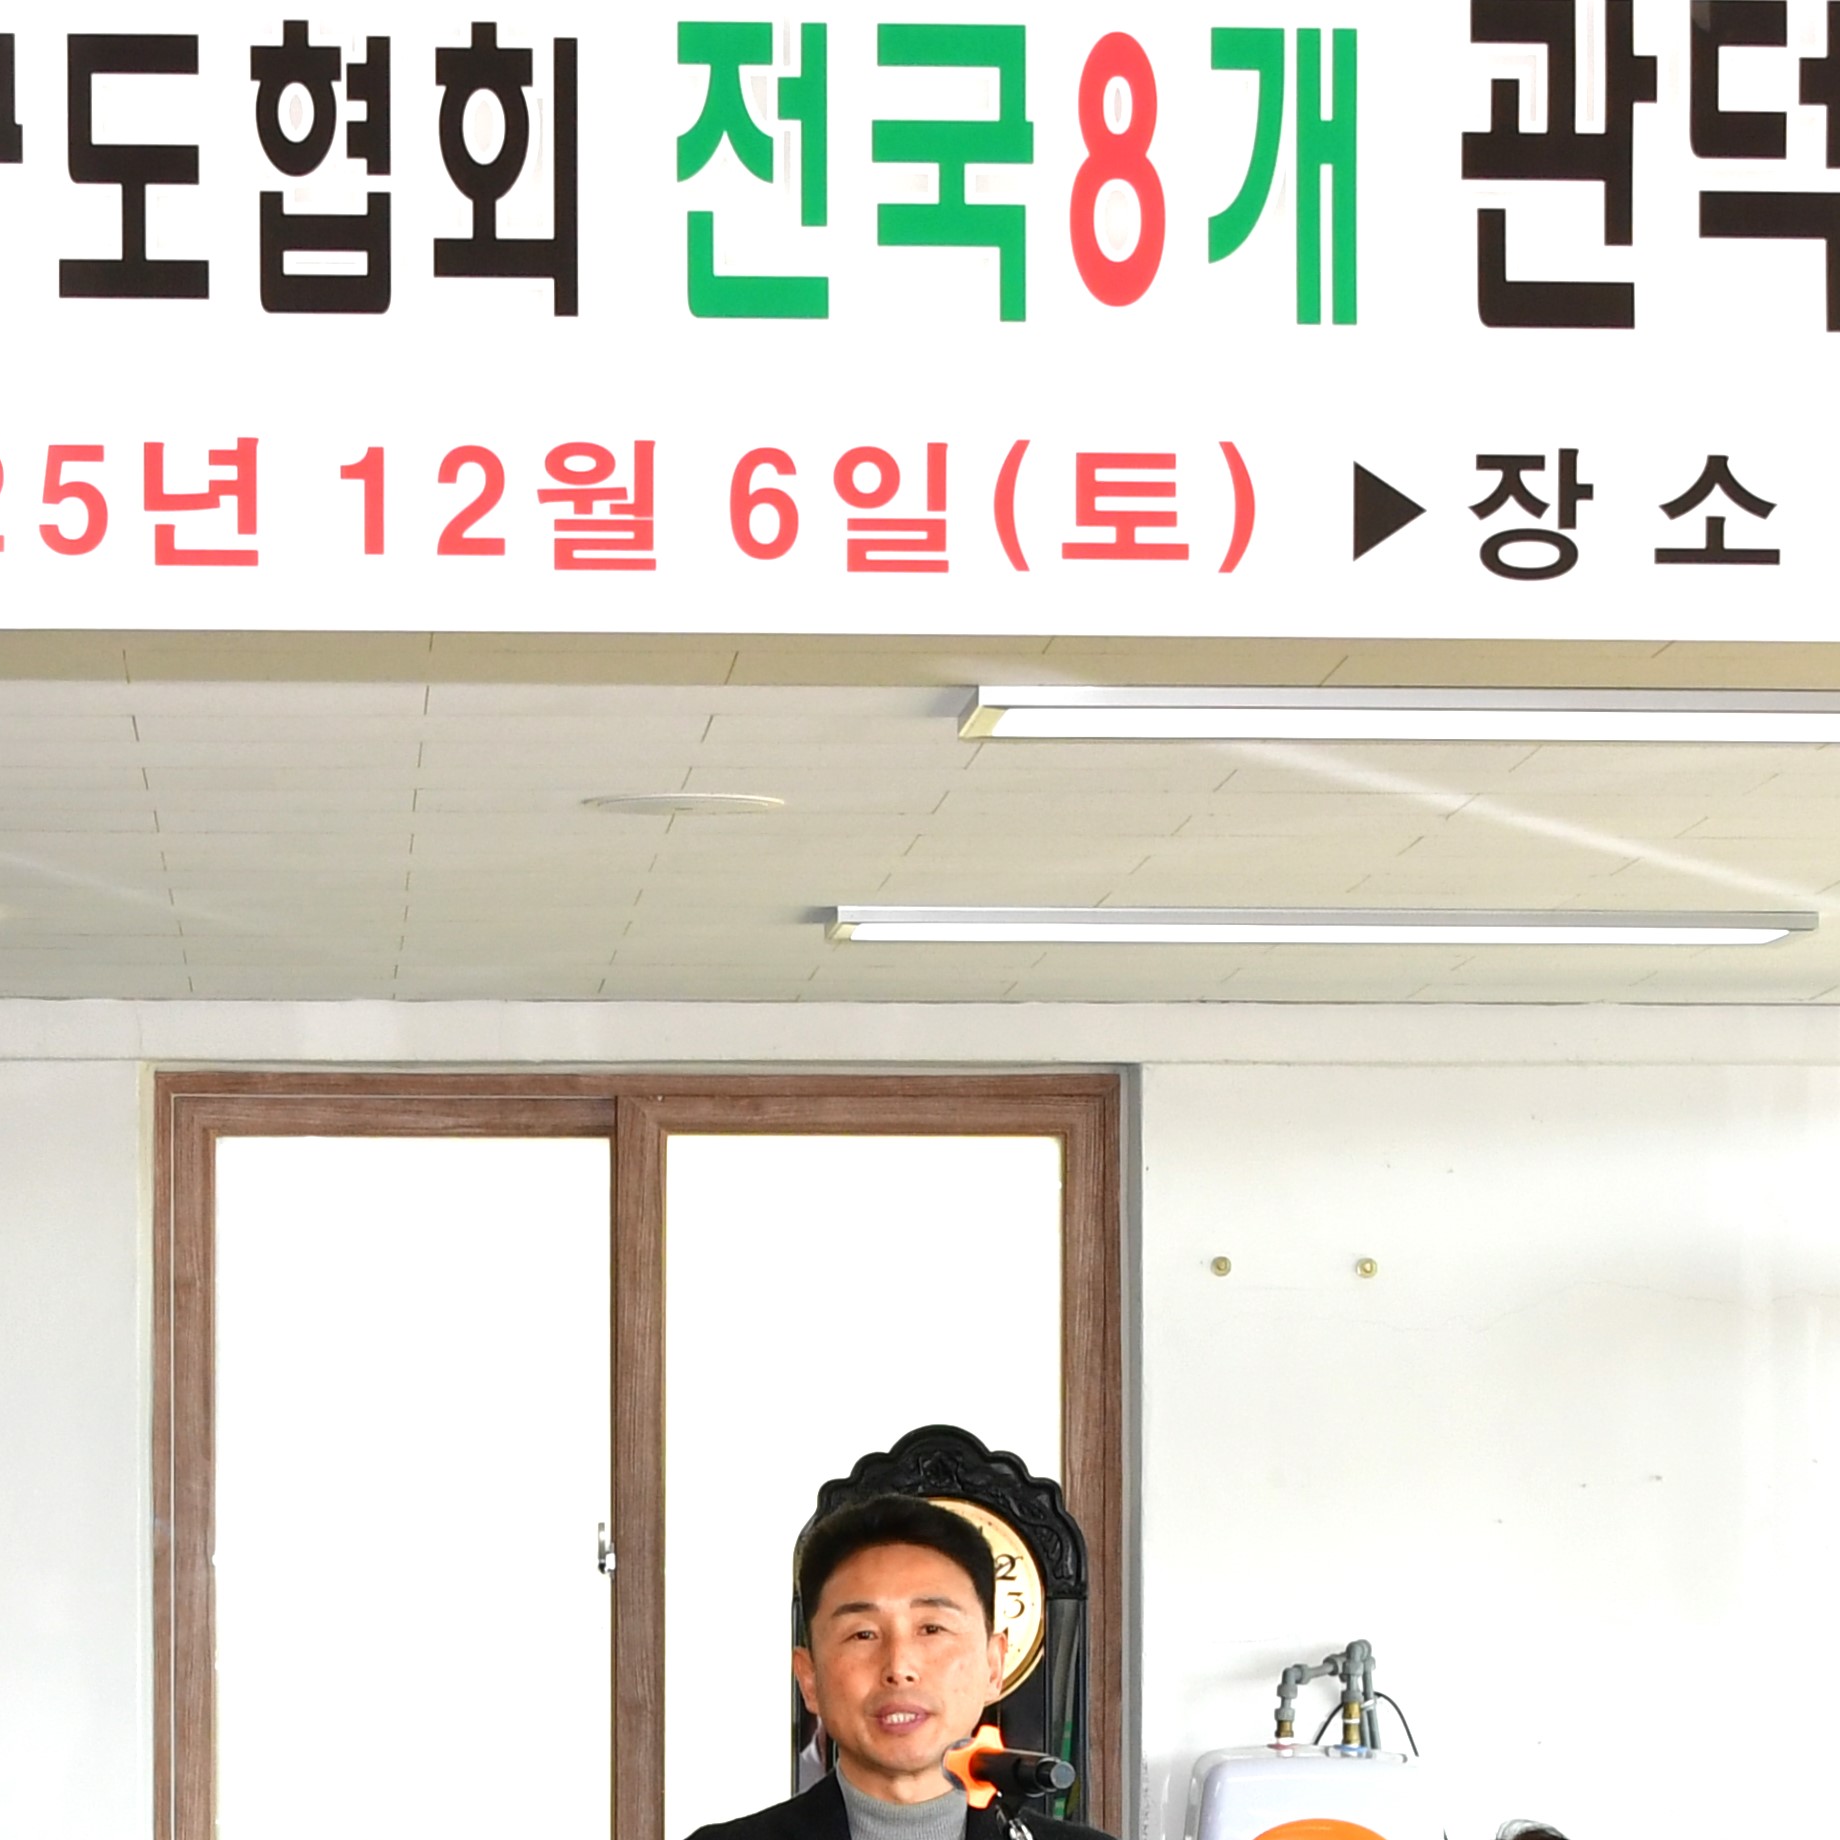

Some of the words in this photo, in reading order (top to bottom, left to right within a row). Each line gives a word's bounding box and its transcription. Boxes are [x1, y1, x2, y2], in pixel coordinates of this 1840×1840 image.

[677, 22, 1357, 324] 전국8개
[340, 440, 656, 570] 12월
[730, 440, 1255, 573] 6일(토)
